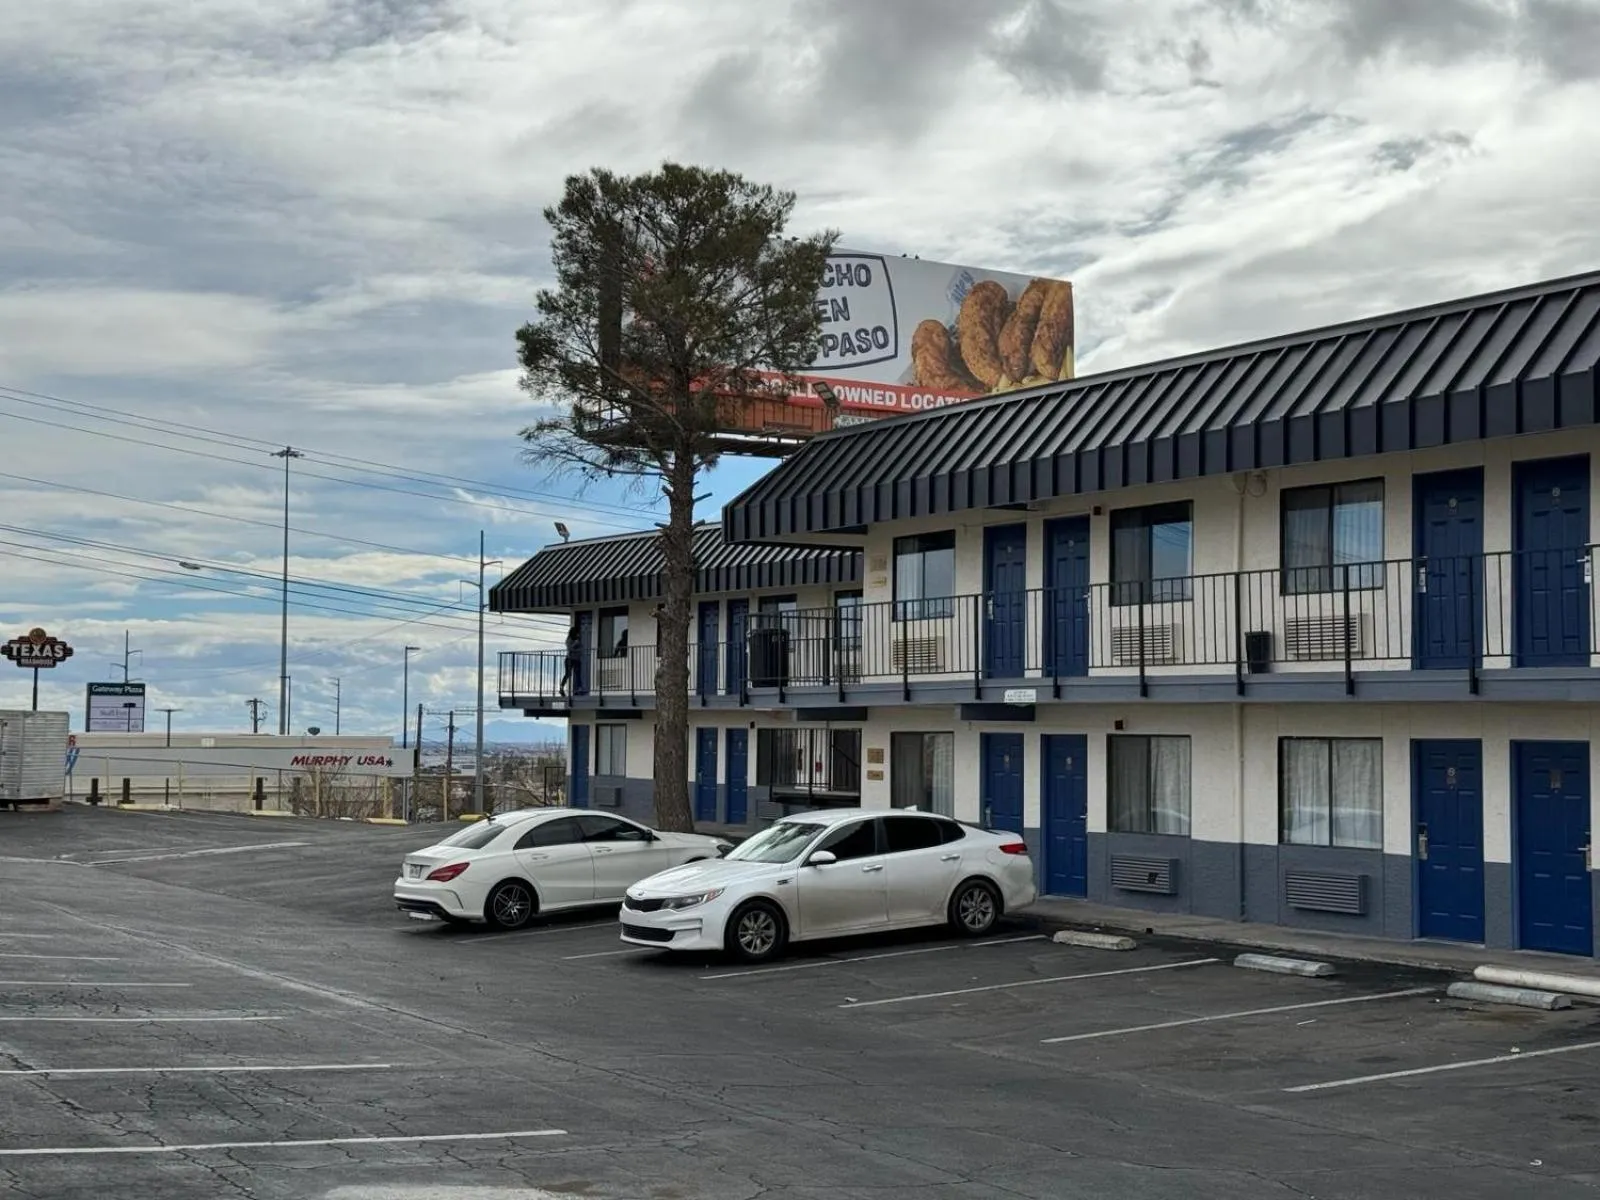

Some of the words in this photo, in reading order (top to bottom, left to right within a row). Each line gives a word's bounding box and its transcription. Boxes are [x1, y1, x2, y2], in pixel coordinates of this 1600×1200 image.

[821, 325, 889, 358] PASO
[832, 384, 897, 407] OWNED
[10, 643, 64, 658] TEXAS
[290, 755, 353, 766] MURPHY
[357, 755, 385, 766] USA
